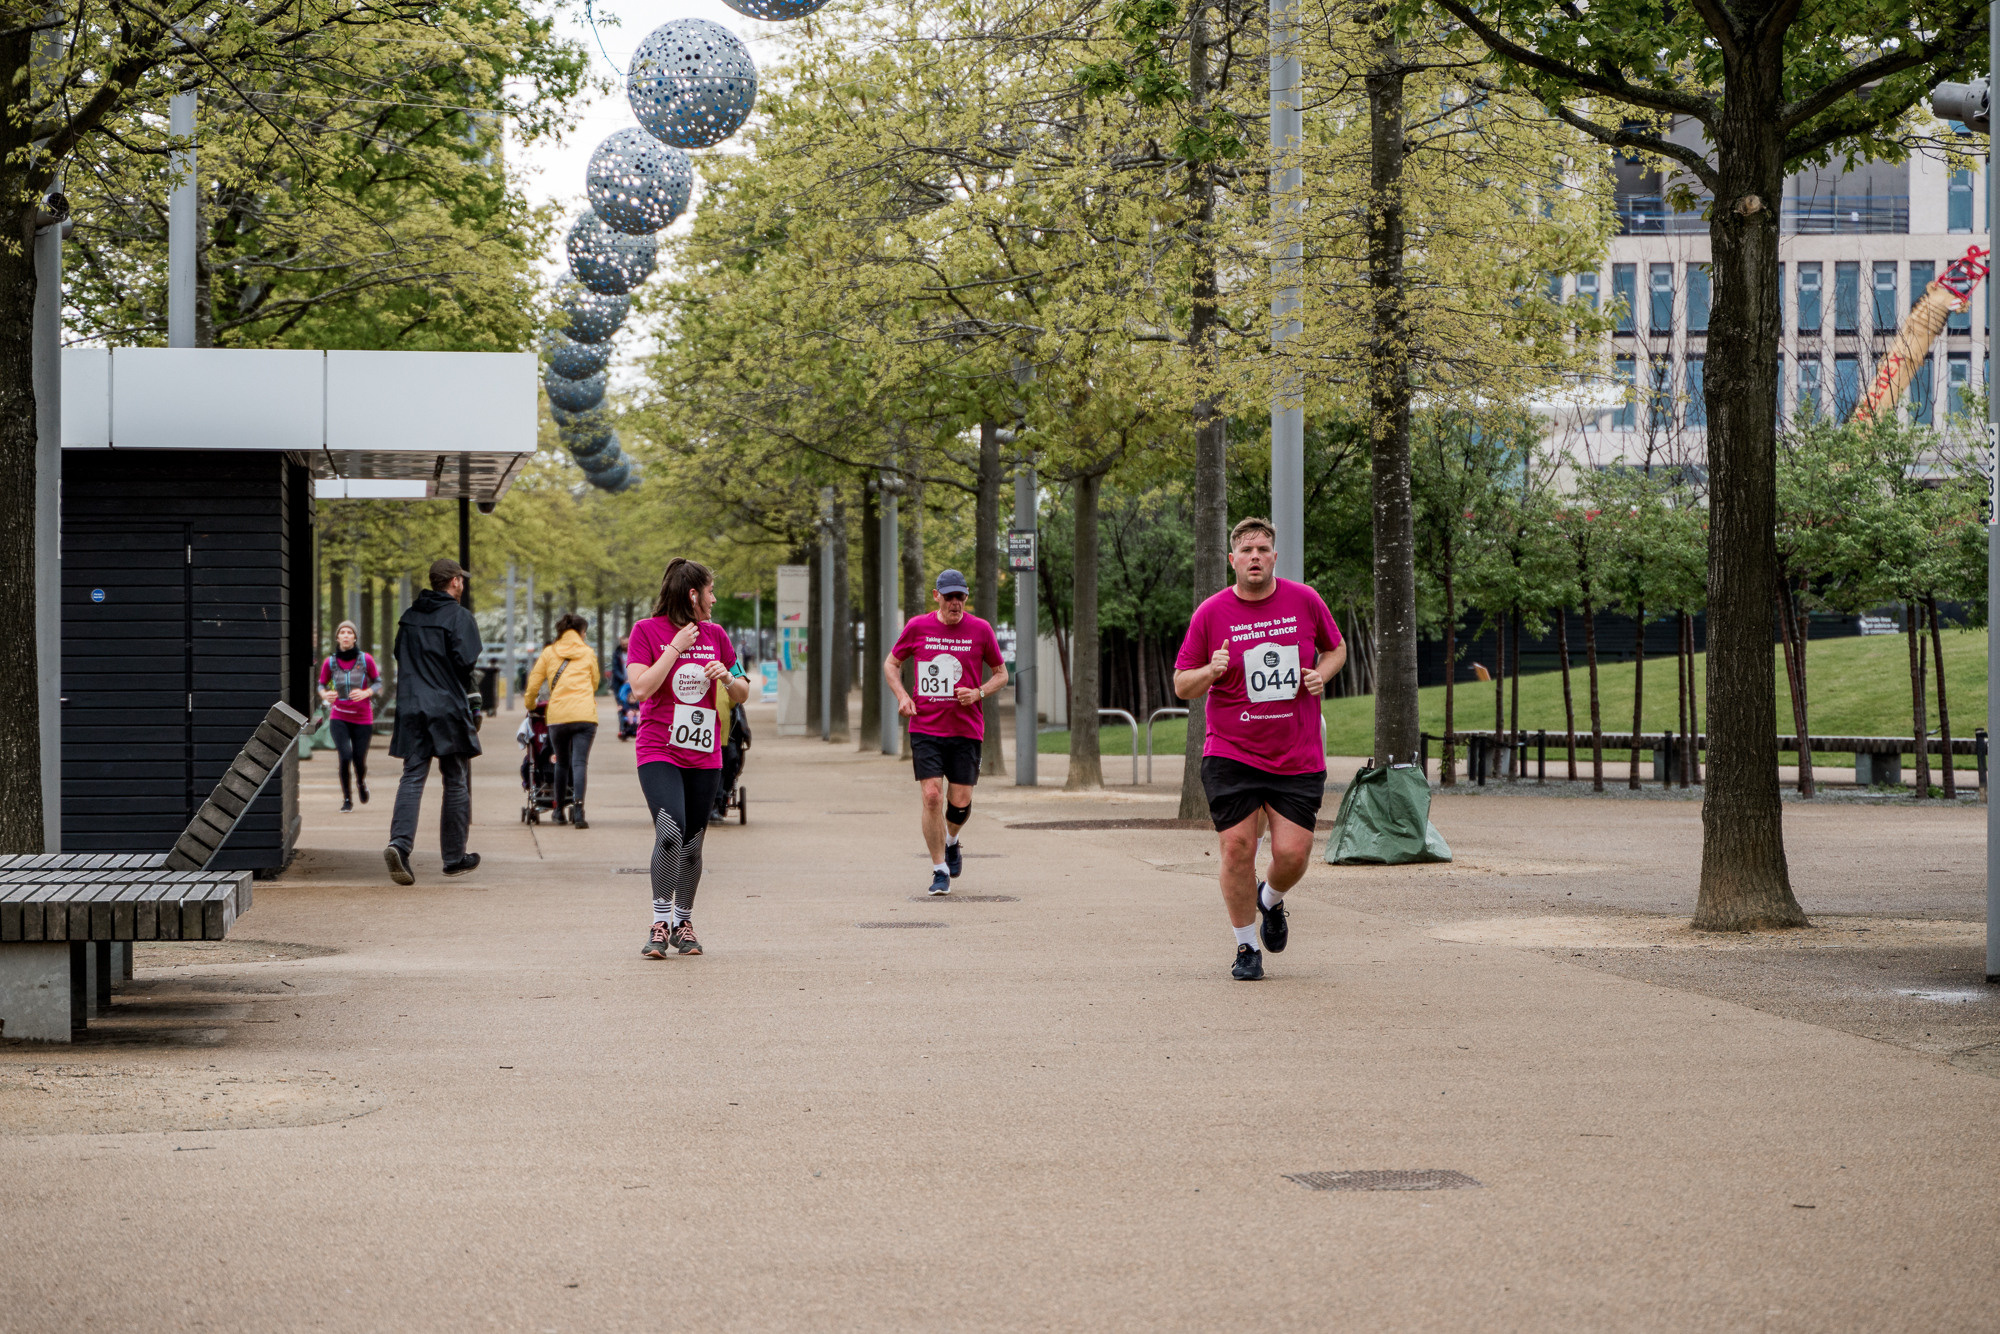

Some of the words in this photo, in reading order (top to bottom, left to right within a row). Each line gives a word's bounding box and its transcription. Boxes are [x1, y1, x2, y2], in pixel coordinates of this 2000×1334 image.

[1230, 623, 1252, 632] Taking
[1254, 620, 1272, 628] steps
[1282, 616, 1297, 624] beat
[942, 637, 955, 645] steps
[1232, 630, 1266, 642] ovarian
[1268, 625, 1298, 637] cancer
[924, 643, 949, 651] ovarian
[950, 644, 972, 652] cancer
[921, 677, 949, 693] 031
[1251, 668, 1298, 692] 044
[675, 725, 712, 748] 048
